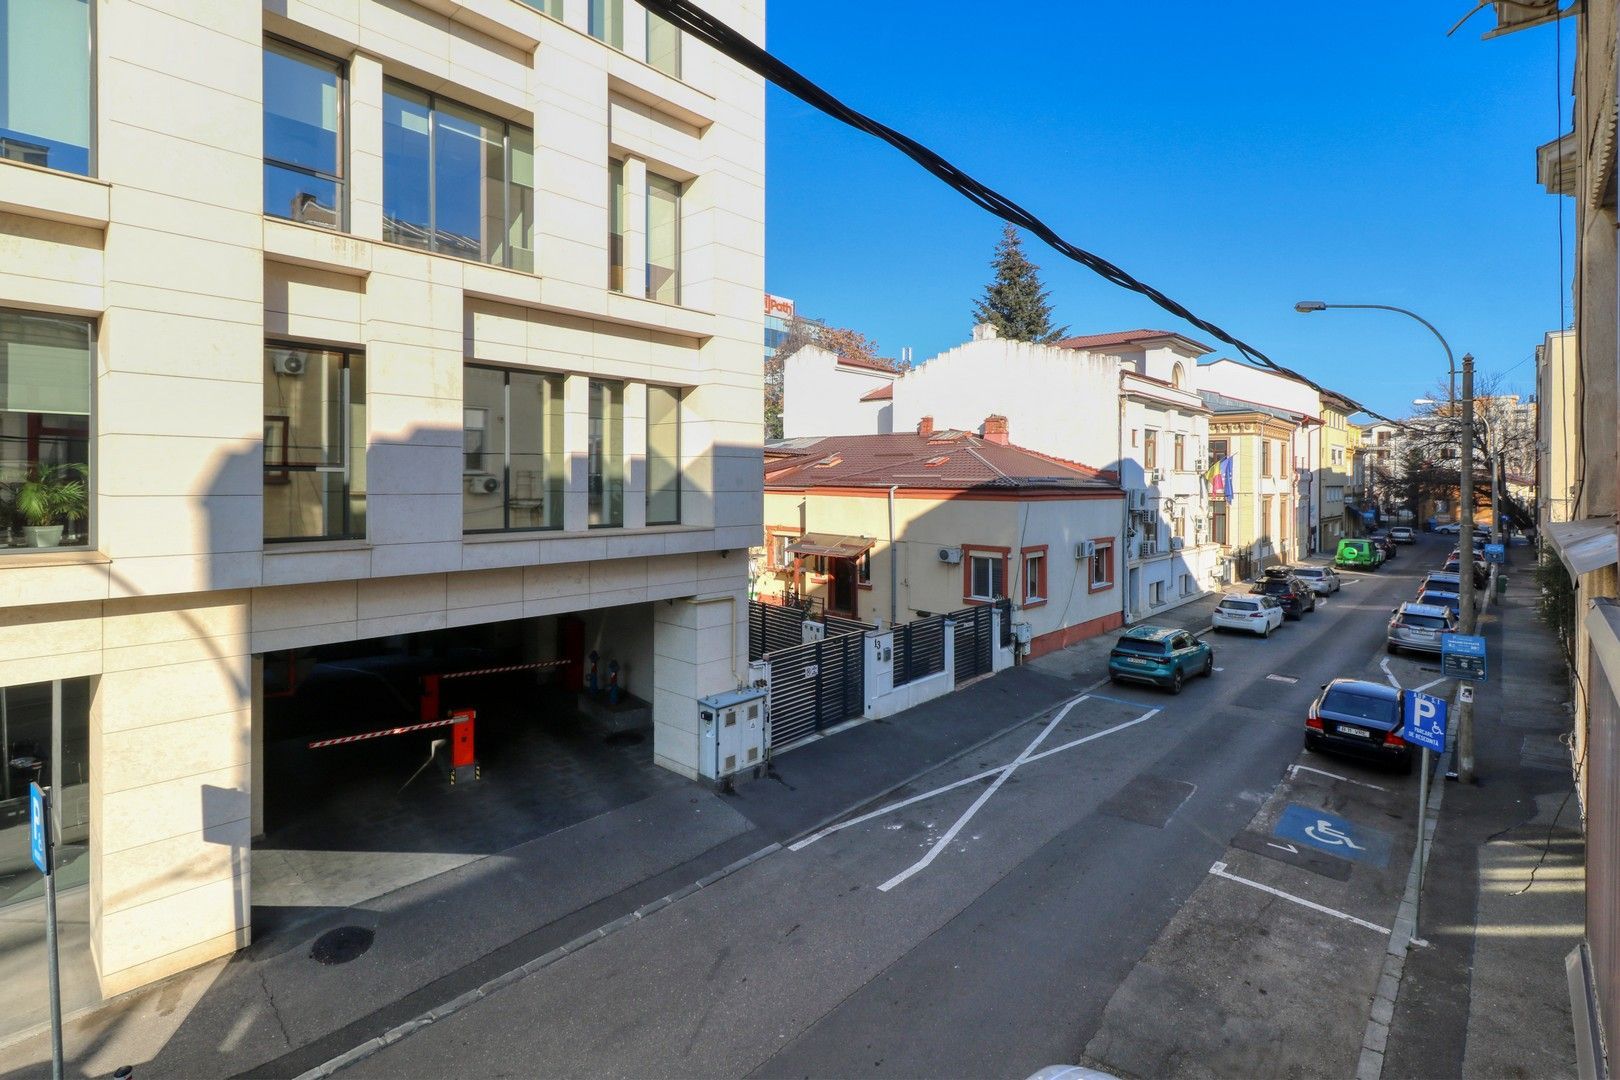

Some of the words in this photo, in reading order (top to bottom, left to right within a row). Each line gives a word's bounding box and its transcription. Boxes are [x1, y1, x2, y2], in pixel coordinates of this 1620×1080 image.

[874, 639, 881, 650] 13
[1414, 697, 1436, 727] P
[33, 796, 40, 840] P
